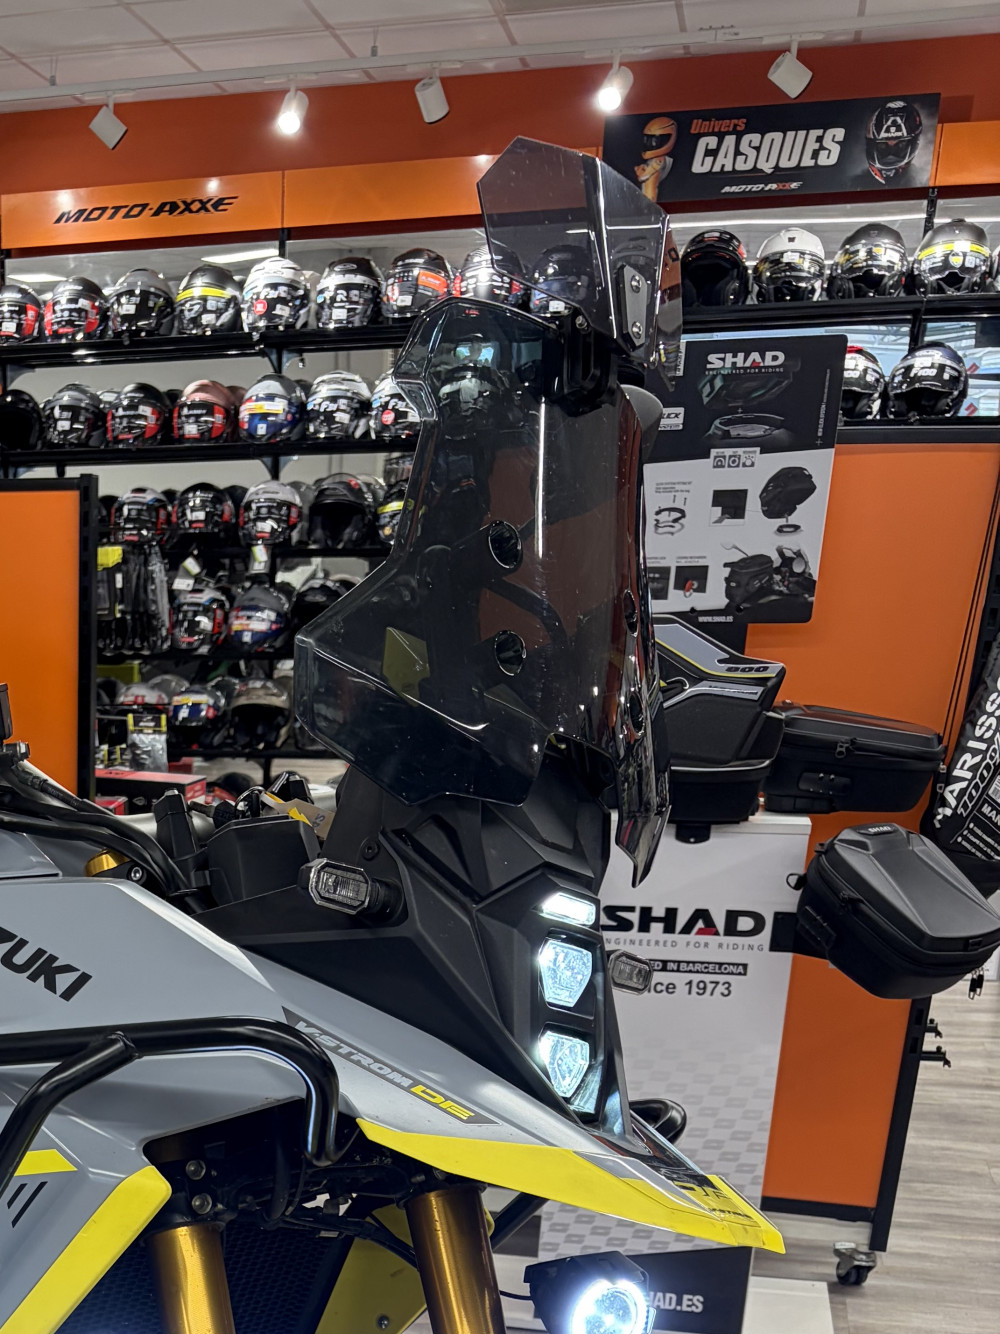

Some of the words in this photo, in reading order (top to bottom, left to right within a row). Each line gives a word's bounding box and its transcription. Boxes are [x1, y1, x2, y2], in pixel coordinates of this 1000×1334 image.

[690, 118, 747, 135] Univers
[691, 127, 846, 174] CASQUES
[706, 351, 785, 369] SHAD
[933, 676, 1000, 829] MARISS
[600, 905, 767, 938] SHAD
[605, 938, 678, 948] NGINEERED
[686, 940, 710, 949] FOR
[718, 942, 765, 952] RIDING
[667, 962, 680, 972] IN
[680, 962, 745, 974] BARCELONA
[684, 979, 733, 997] 1973
[294, 1020, 414, 1088] V-STROM
